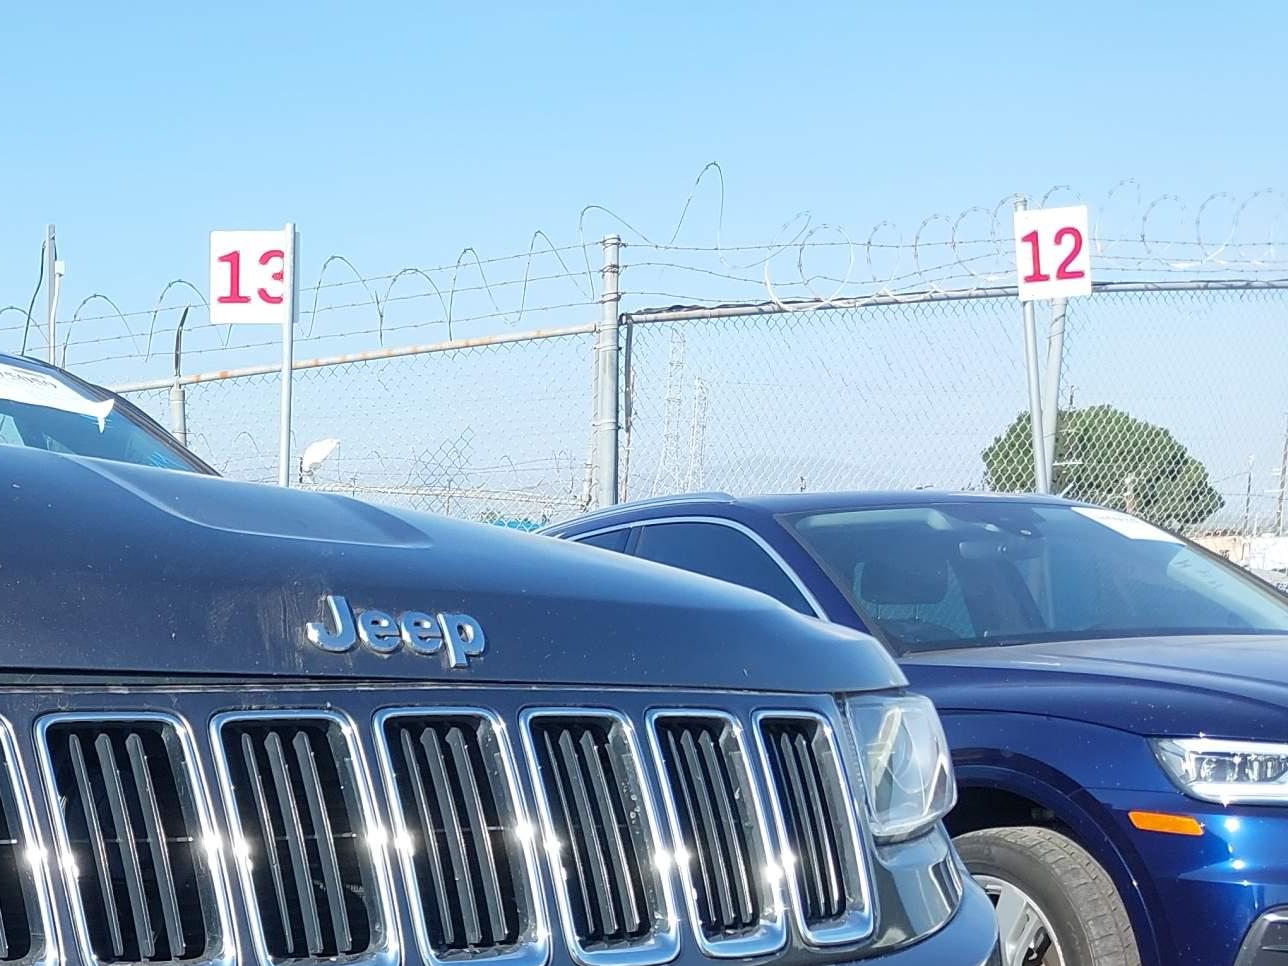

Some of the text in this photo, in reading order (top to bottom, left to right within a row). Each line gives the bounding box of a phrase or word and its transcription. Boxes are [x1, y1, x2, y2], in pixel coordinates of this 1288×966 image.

[217, 249, 285, 305] 13
[1020, 226, 1086, 284] 12
[305, 594, 486, 669] Jeep
